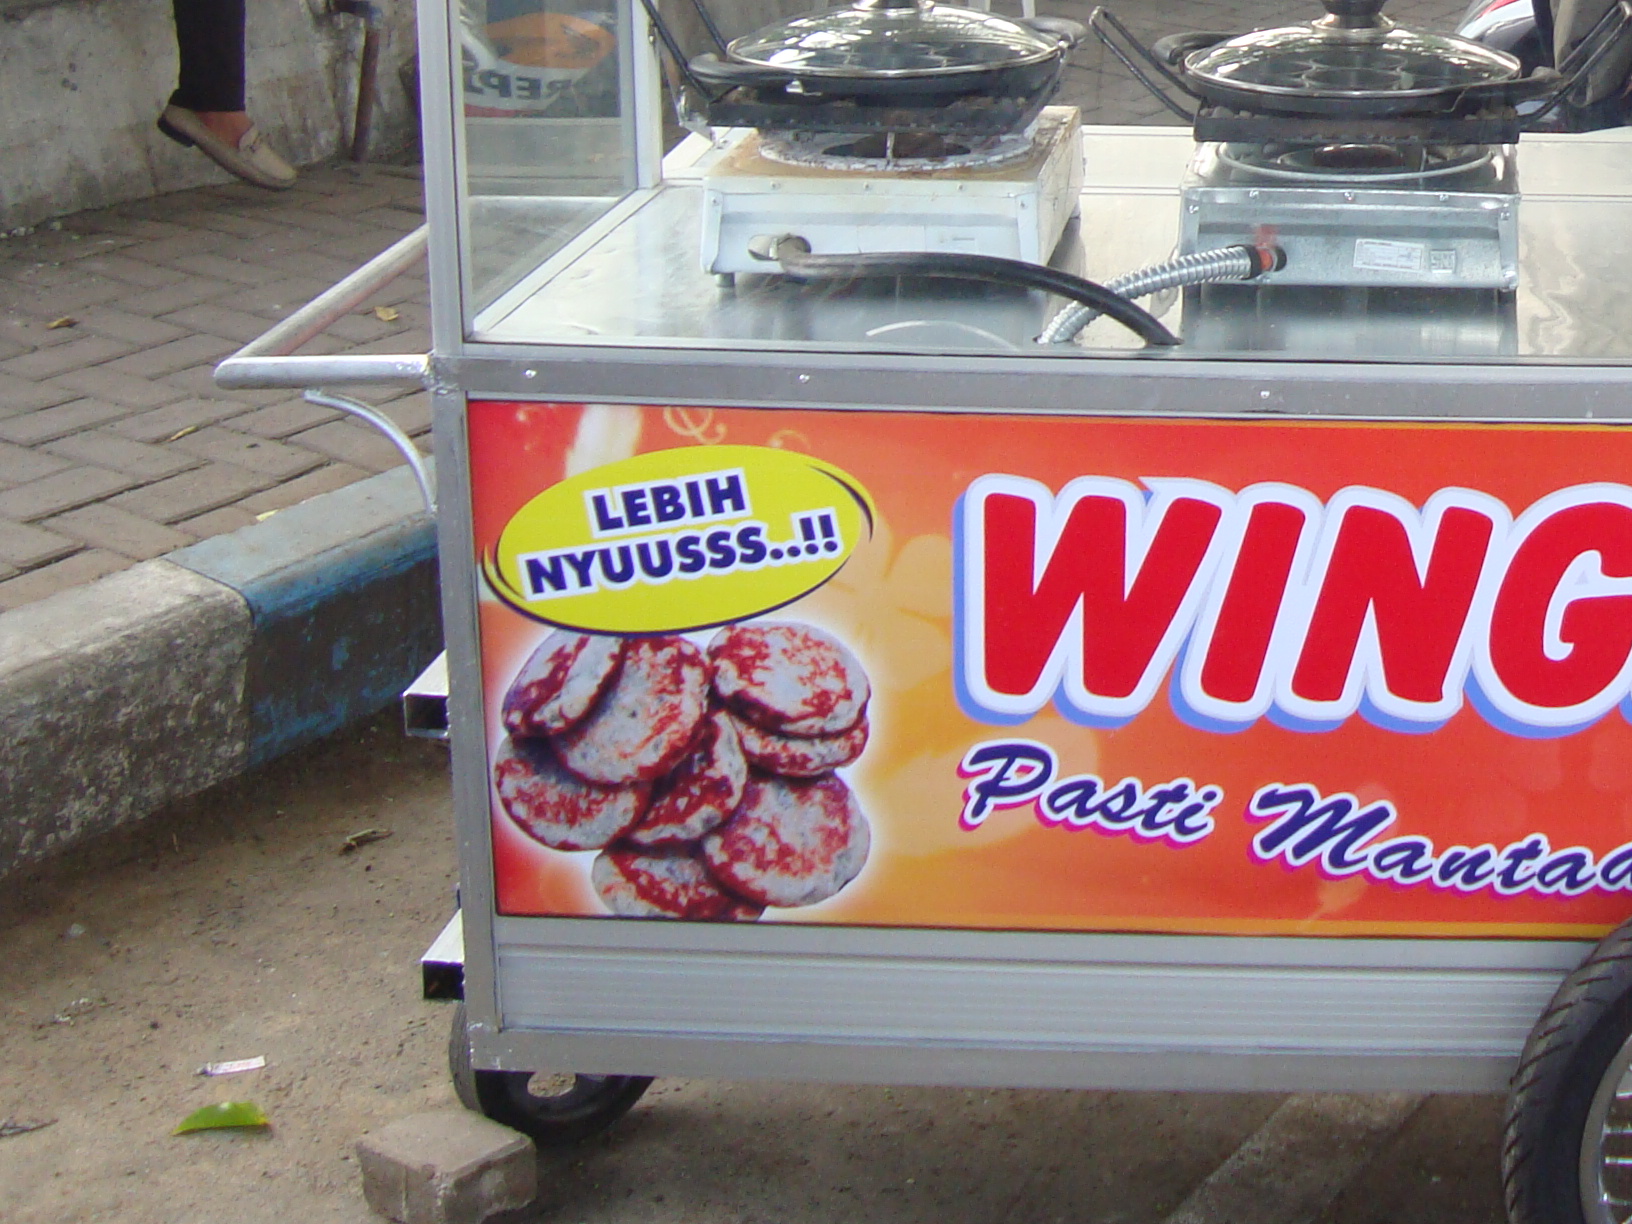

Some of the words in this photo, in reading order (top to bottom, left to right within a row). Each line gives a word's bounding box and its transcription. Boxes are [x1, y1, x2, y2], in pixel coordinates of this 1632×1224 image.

[589, 472, 748, 535] LEBIH
[522, 511, 840, 596] NYUUSSS..!!
[960, 740, 1221, 843] Pasti
